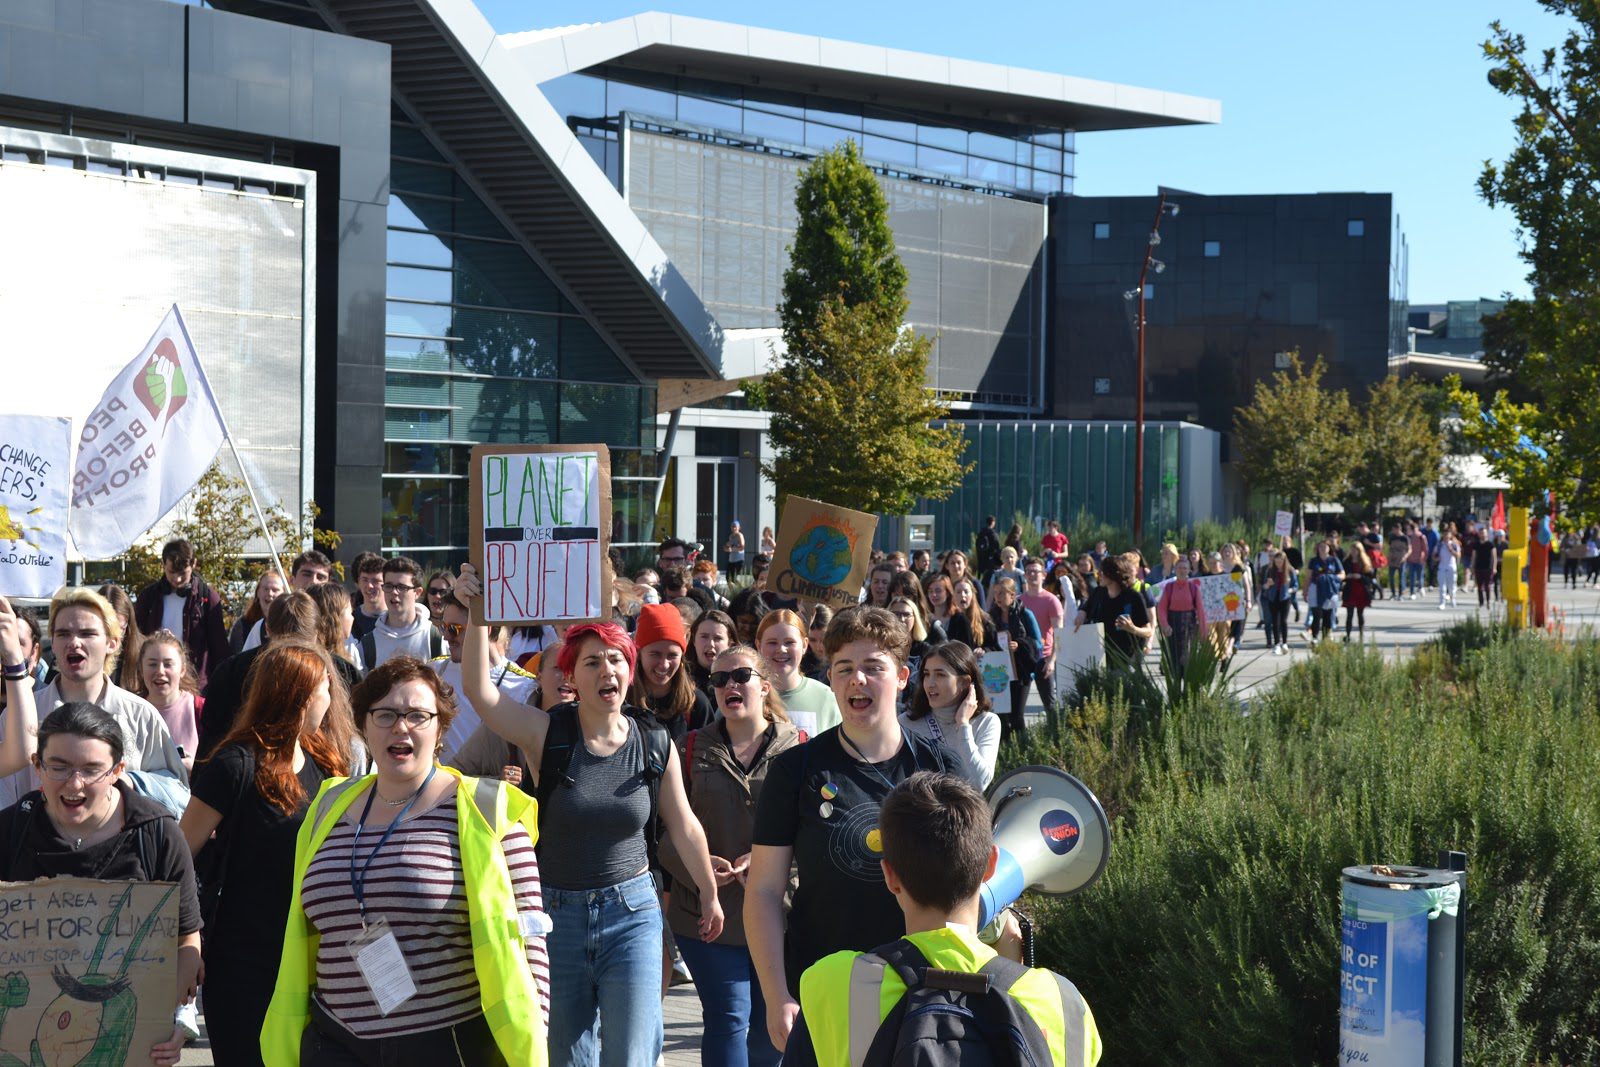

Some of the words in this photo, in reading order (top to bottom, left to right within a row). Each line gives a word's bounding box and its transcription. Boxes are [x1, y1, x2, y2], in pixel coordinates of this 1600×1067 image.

[0, 444, 51, 478] CHANGE
[487, 456, 597, 527] PLANET
[524, 527, 552, 541] OVER
[487, 541, 598, 619] PROFIT
[47, 892, 98, 910] AREA
[47, 916, 93, 941] FOR
[43, 949, 82, 962] STOP
[1358, 954, 1378, 968] OF
[1346, 1048, 1369, 1064] you
